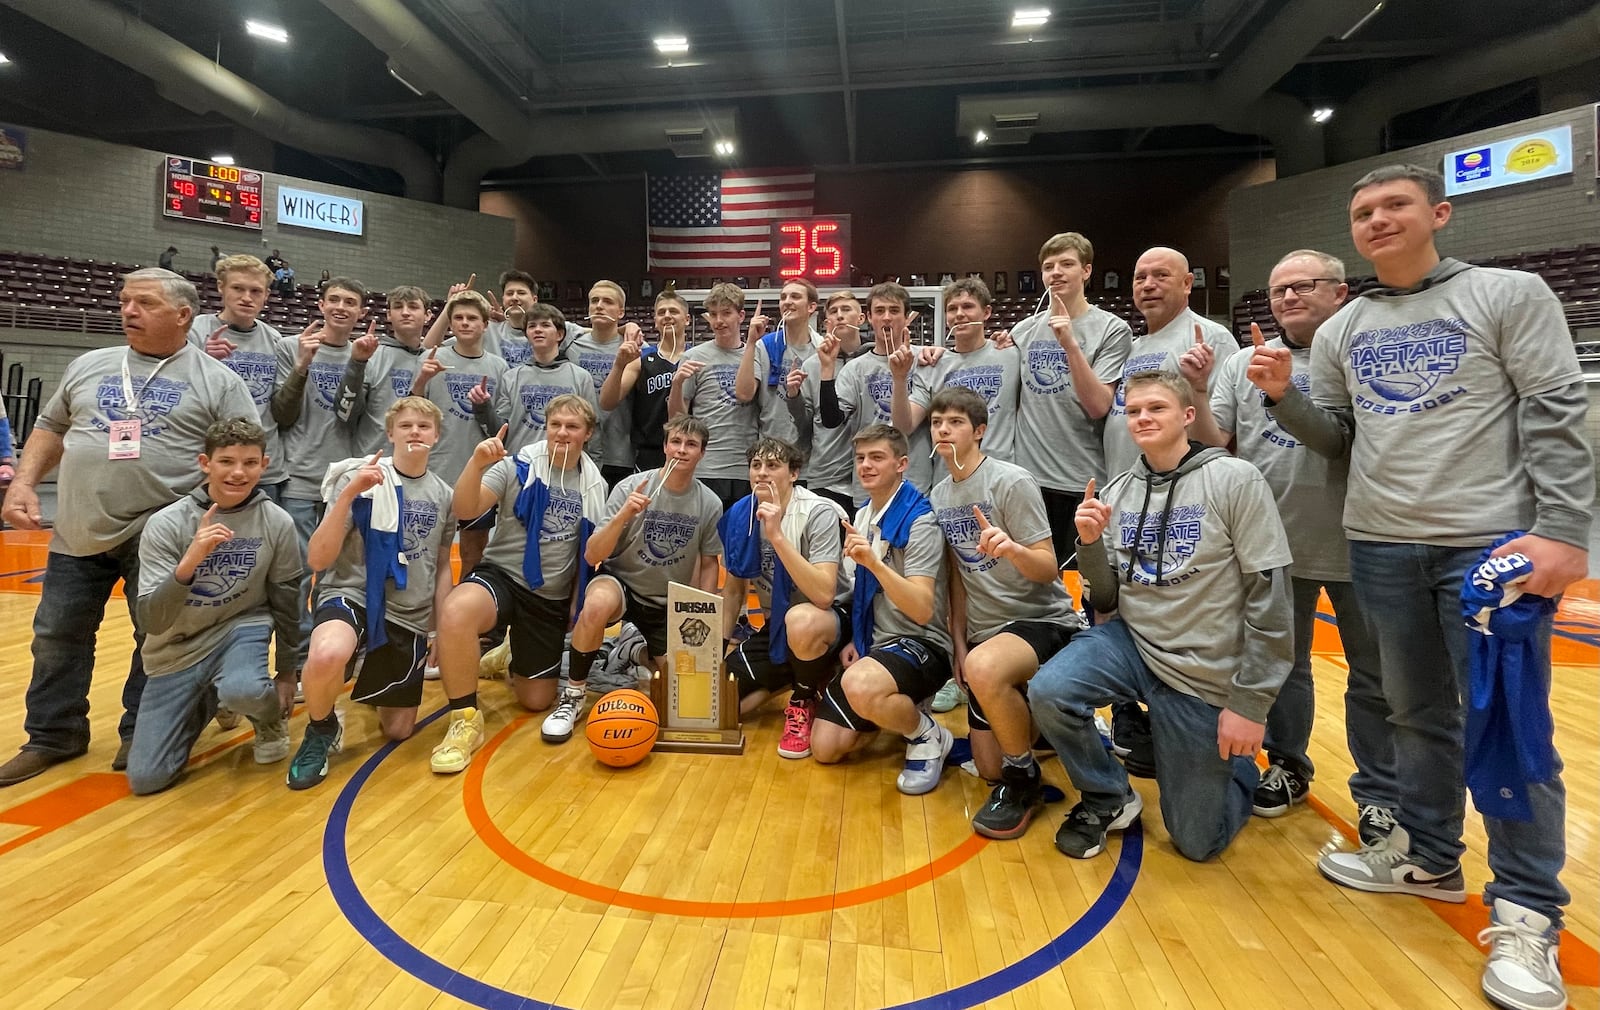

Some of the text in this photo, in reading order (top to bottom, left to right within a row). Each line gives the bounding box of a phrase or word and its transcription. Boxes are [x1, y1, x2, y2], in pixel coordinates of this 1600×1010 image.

[172, 173, 193, 183] HOME
[209, 165, 238, 182] 1:00
[173, 181, 195, 197] 48
[210, 188, 221, 199] 4
[236, 185, 259, 194] GUEST
[172, 199, 182, 210] 5
[240, 191, 259, 207] 55
[250, 211, 258, 222] 2
[283, 195, 359, 227] WINGERS
[780, 224, 840, 276] 35
[1356, 354, 1460, 386] CHAMPS
[1355, 386, 1467, 416] 2023-2024
[404, 511, 438, 530] TATE
[597, 699, 645, 715] Wilson
